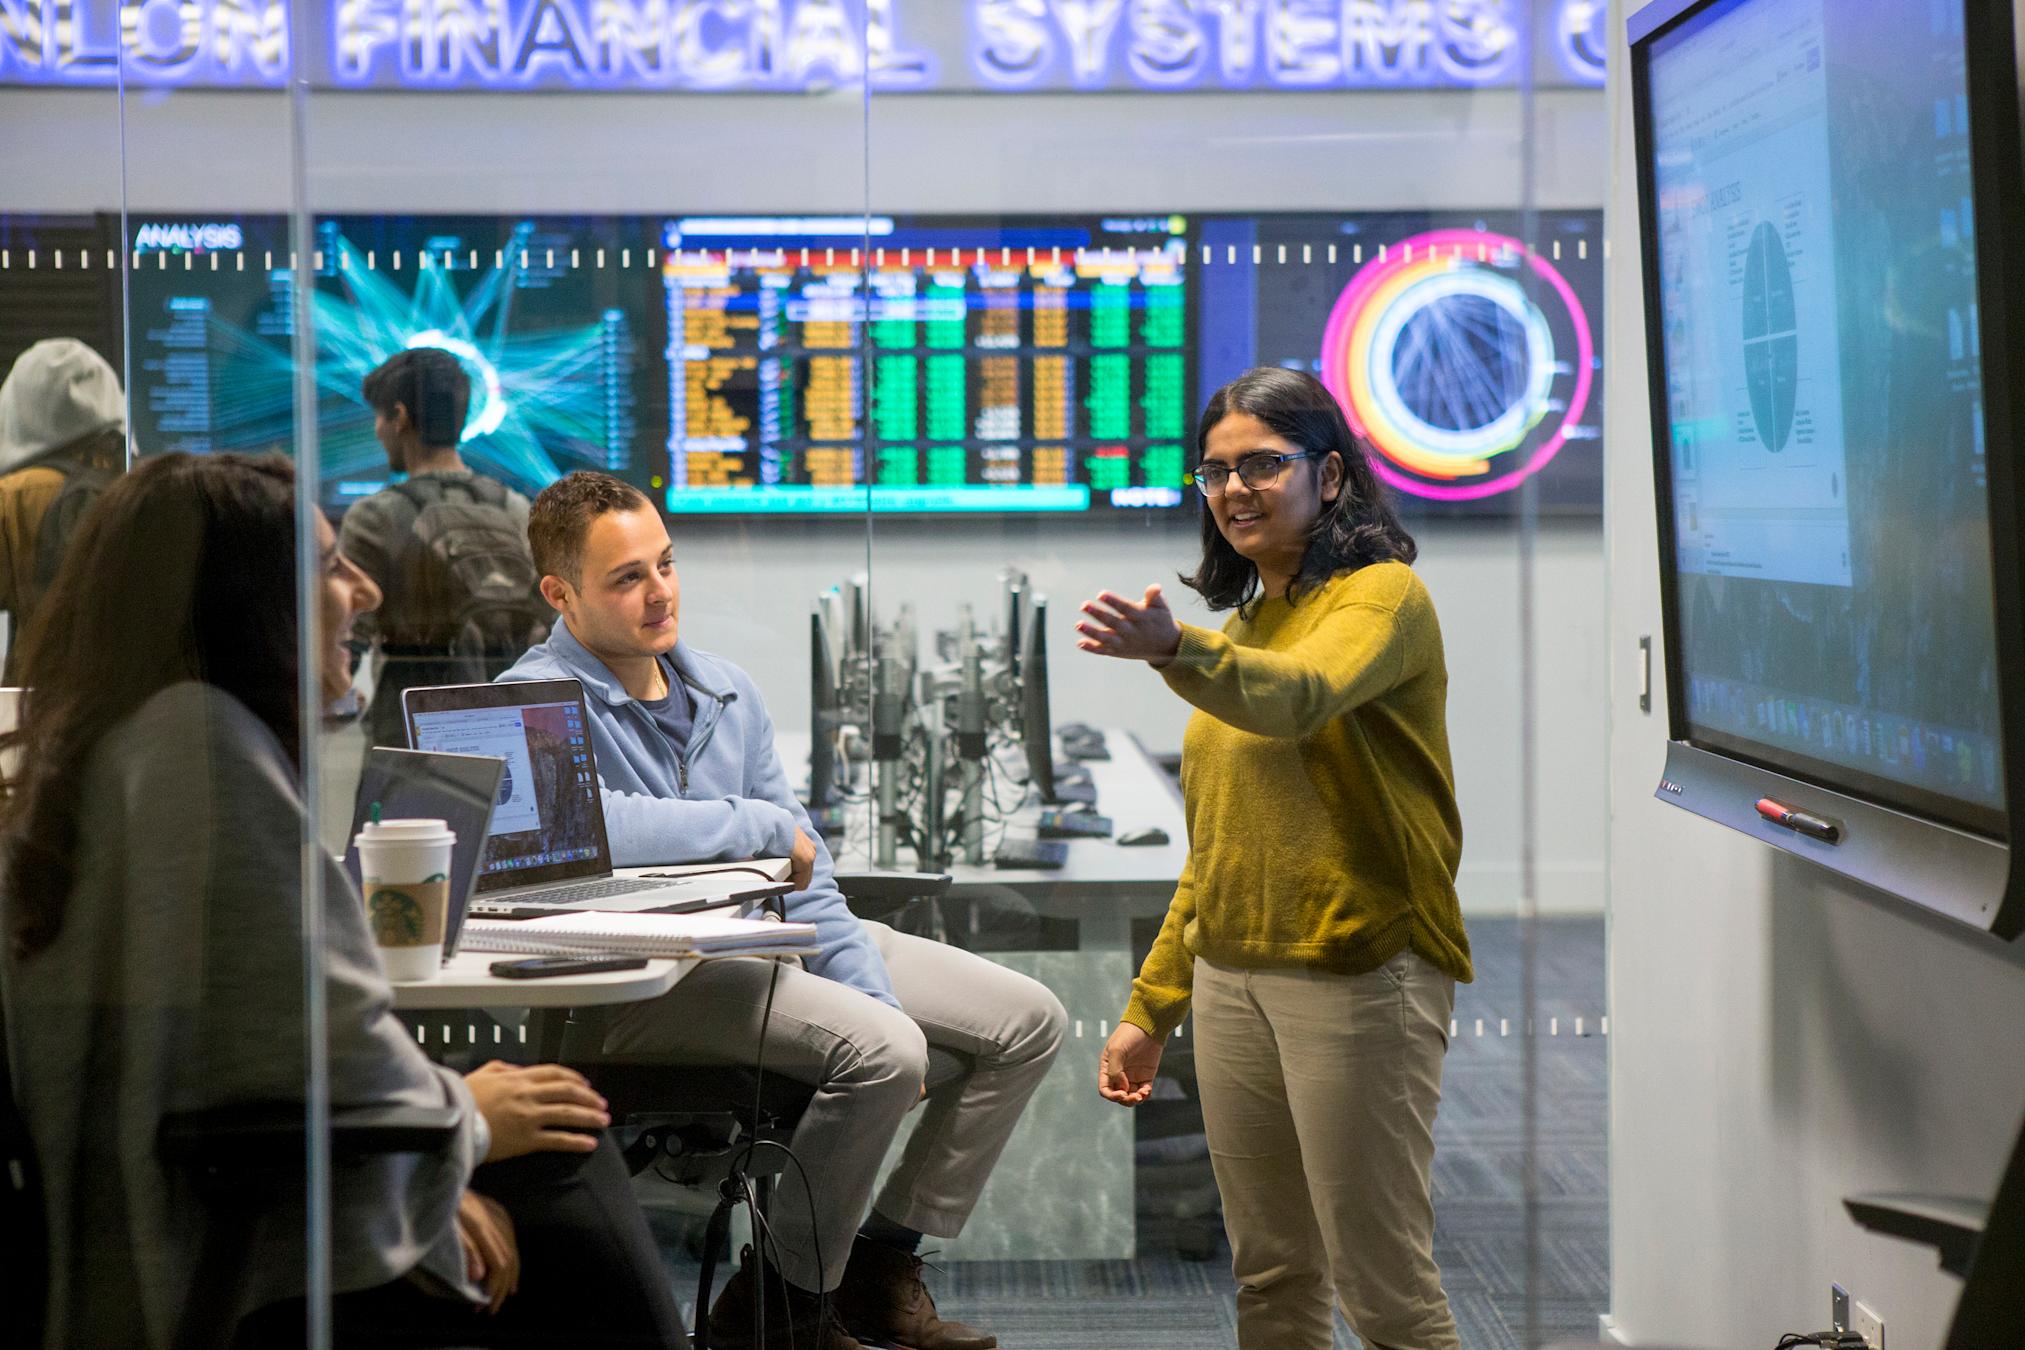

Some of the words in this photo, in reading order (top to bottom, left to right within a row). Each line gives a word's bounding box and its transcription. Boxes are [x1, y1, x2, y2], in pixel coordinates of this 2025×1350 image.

[333, 0, 938, 84] FINANCIAL
[974, 0, 1518, 84] SYSTEMS
[135, 222, 243, 250] ANALYSIS
